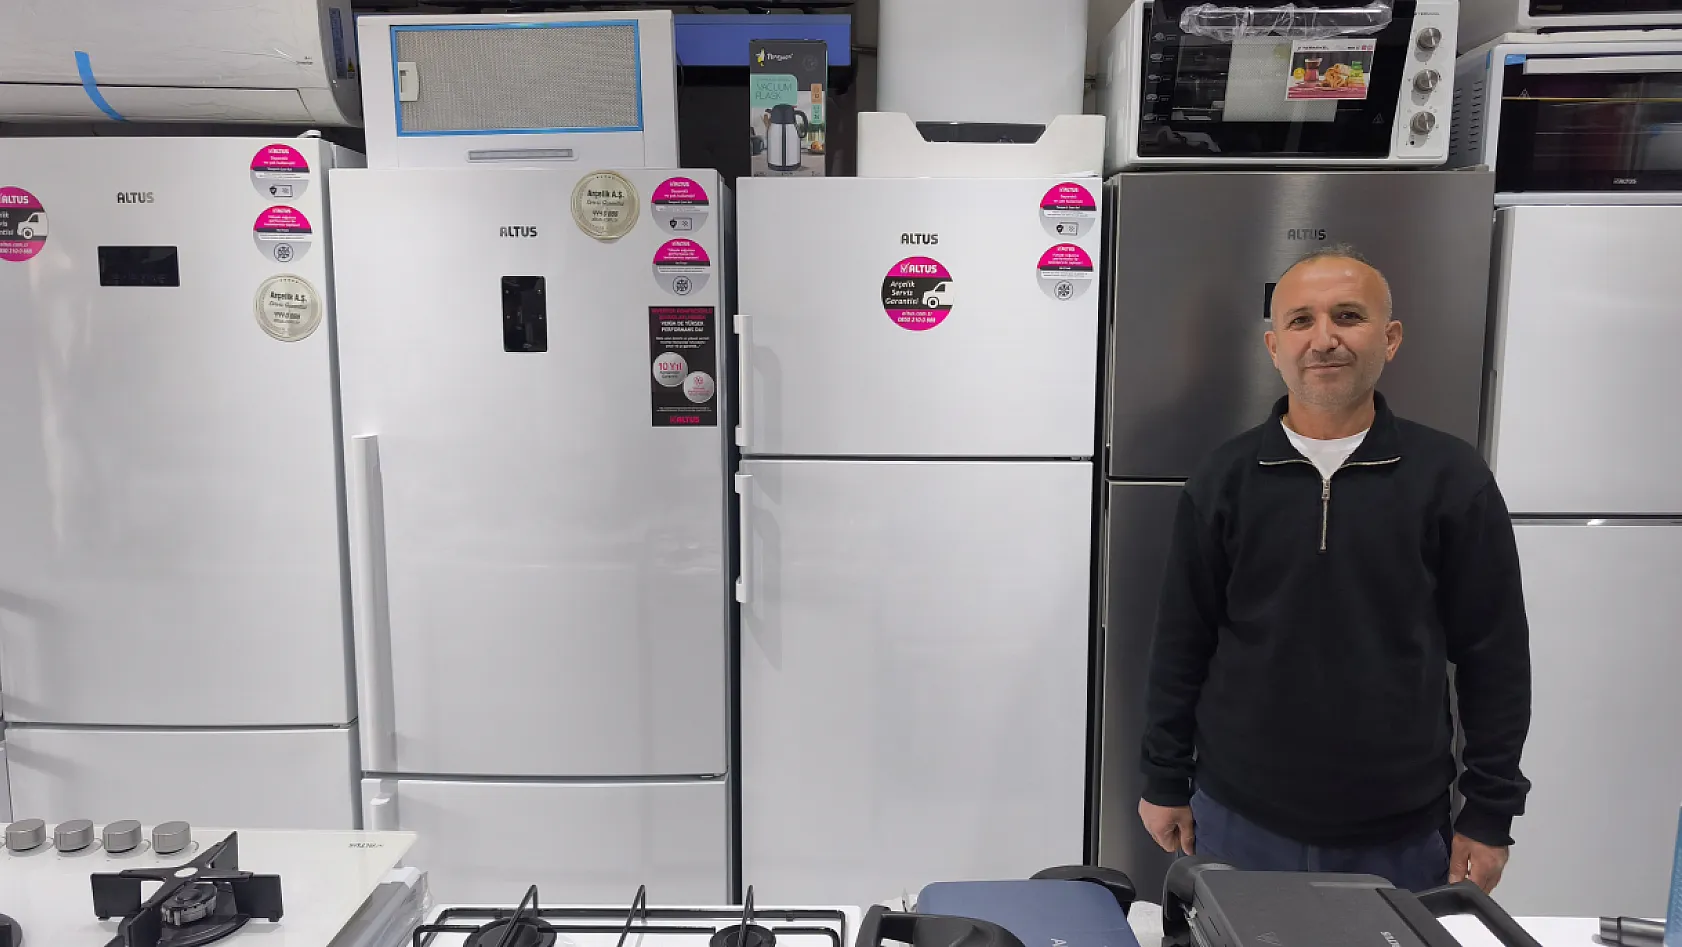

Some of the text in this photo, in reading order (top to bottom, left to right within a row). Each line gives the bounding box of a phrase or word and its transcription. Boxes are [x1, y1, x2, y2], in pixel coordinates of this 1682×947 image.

[756, 83, 792, 92] VACUUM
[756, 92, 781, 100] FLASK
[2, 195, 29, 204] ALTUS
[117, 192, 154, 204] ALTUS
[500, 226, 538, 237] ALTUS
[1288, 228, 1327, 240] ALTUS
[901, 233, 939, 244] ALTUS
[909, 265, 937, 273] ALTUS
[890, 281, 915, 290] Arçelik
[669, 362, 682, 370] Yıl
